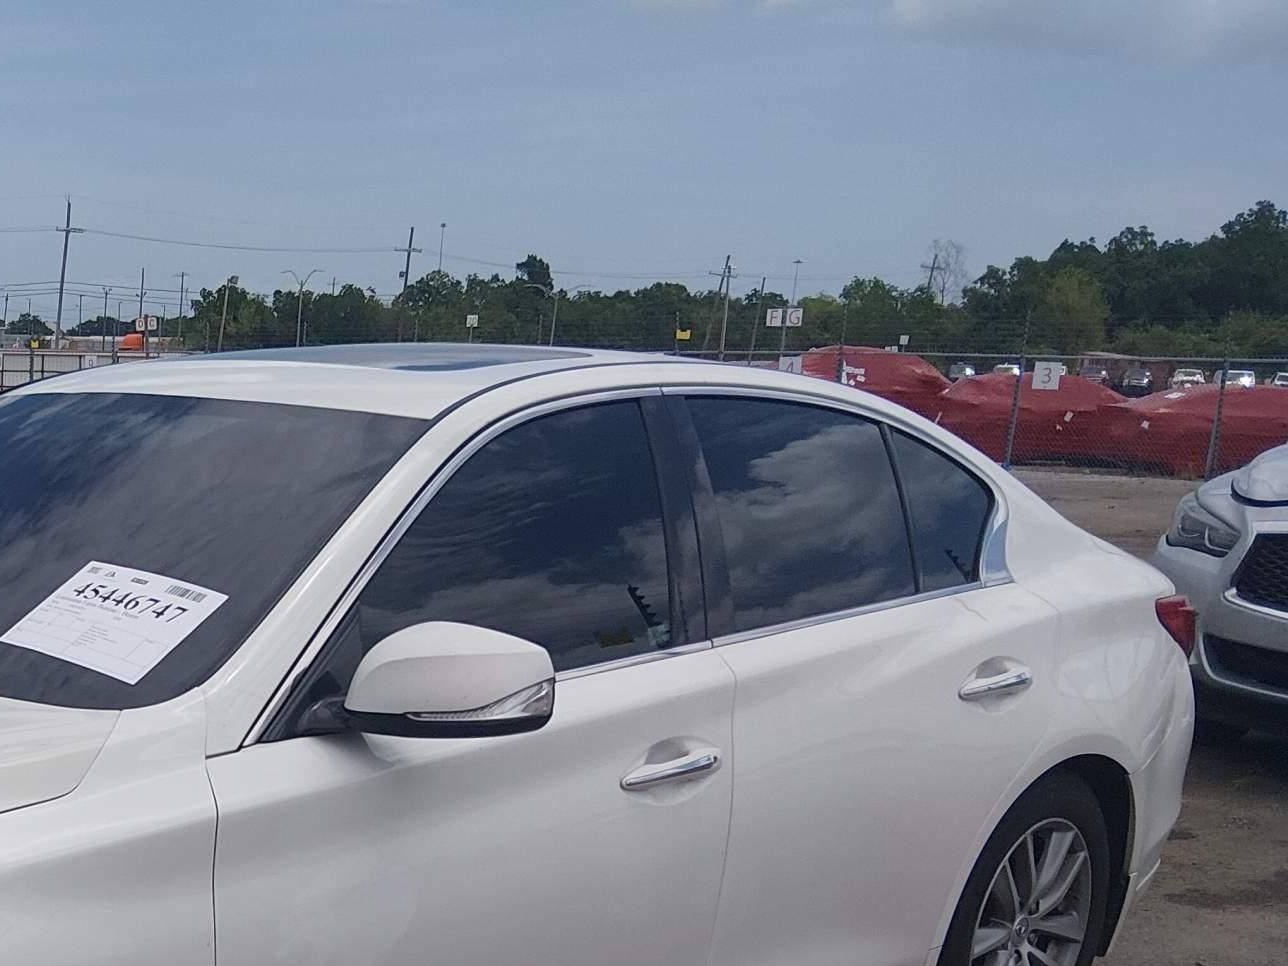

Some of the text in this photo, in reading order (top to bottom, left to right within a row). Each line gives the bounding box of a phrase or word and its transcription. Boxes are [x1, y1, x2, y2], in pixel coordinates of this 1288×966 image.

[770, 310, 779, 326] F
[789, 309, 801, 325] G
[1041, 367, 1052, 384] 3
[73, 582, 189, 623] 45446747
